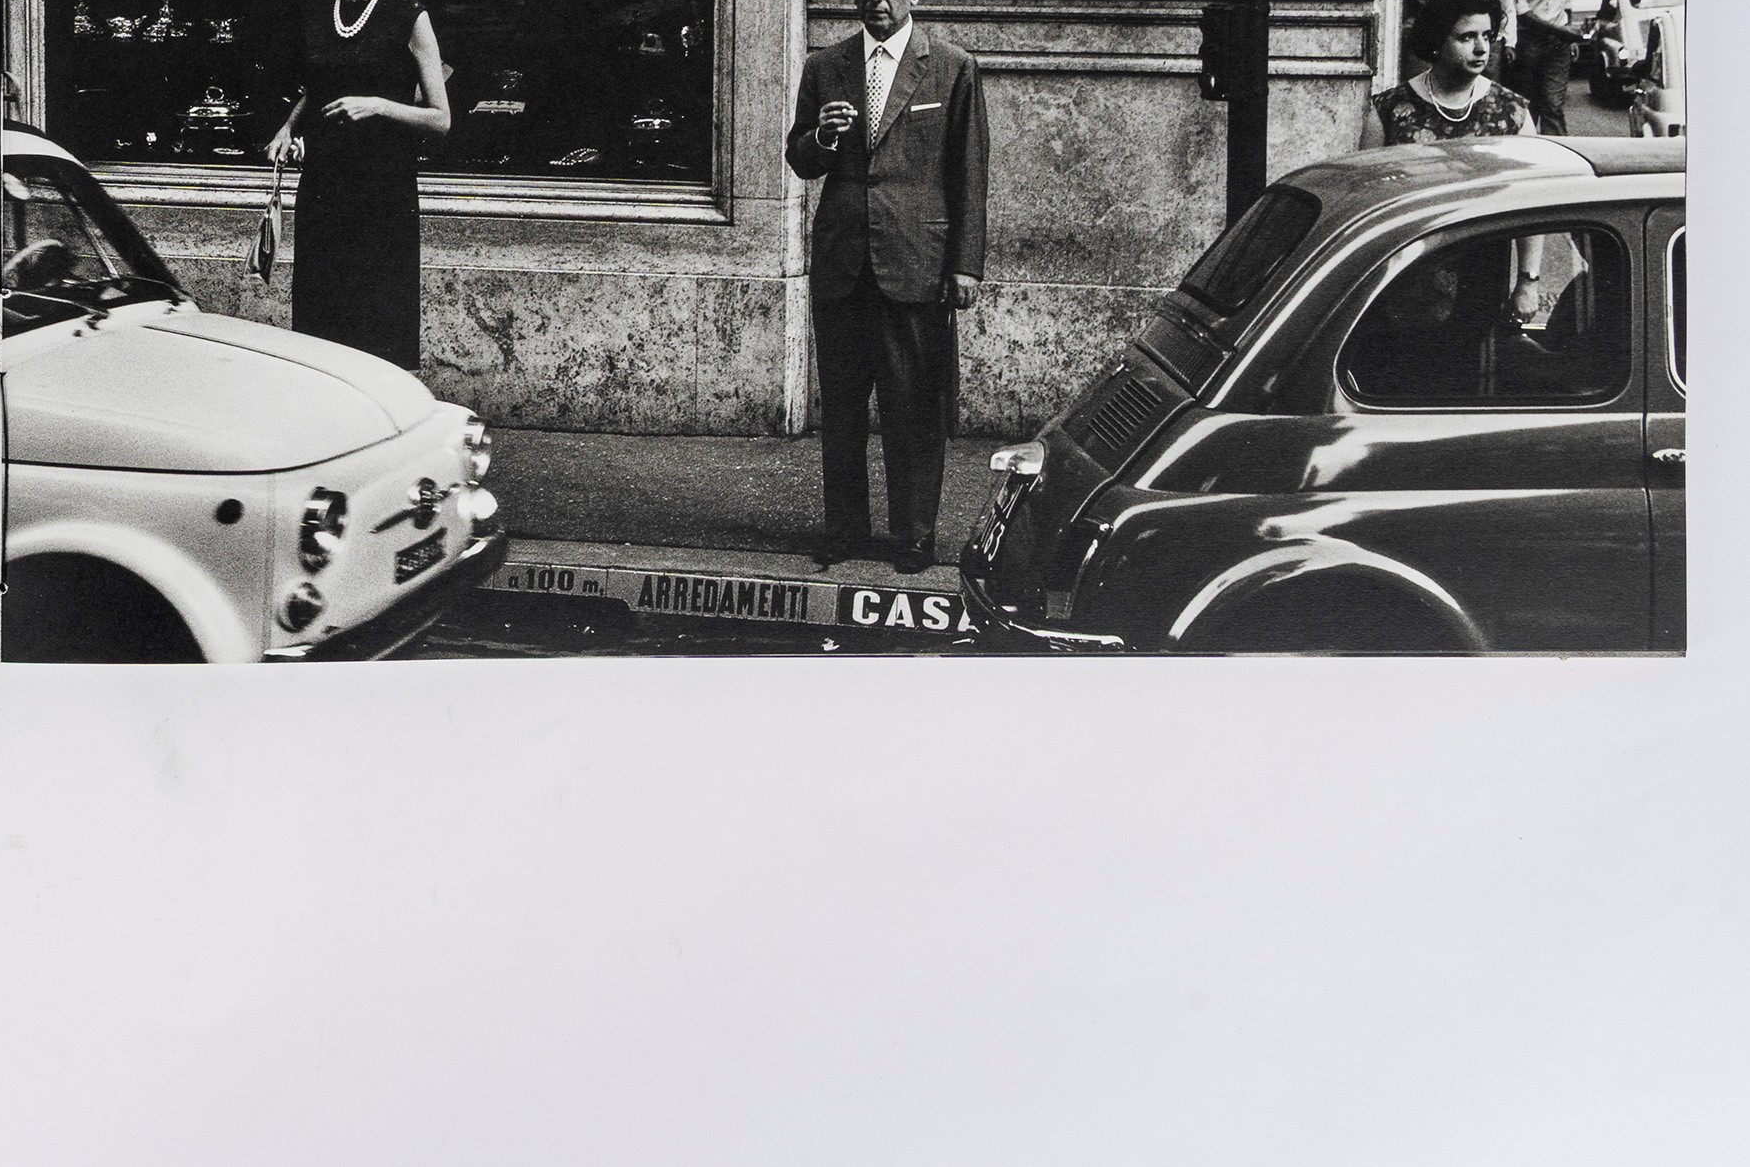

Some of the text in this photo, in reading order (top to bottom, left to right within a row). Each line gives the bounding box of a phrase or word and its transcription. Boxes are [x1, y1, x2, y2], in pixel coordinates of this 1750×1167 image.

[508, 575, 519, 589] a
[526, 568, 575, 591] 100
[637, 574, 809, 620] ARREDAMENTI
